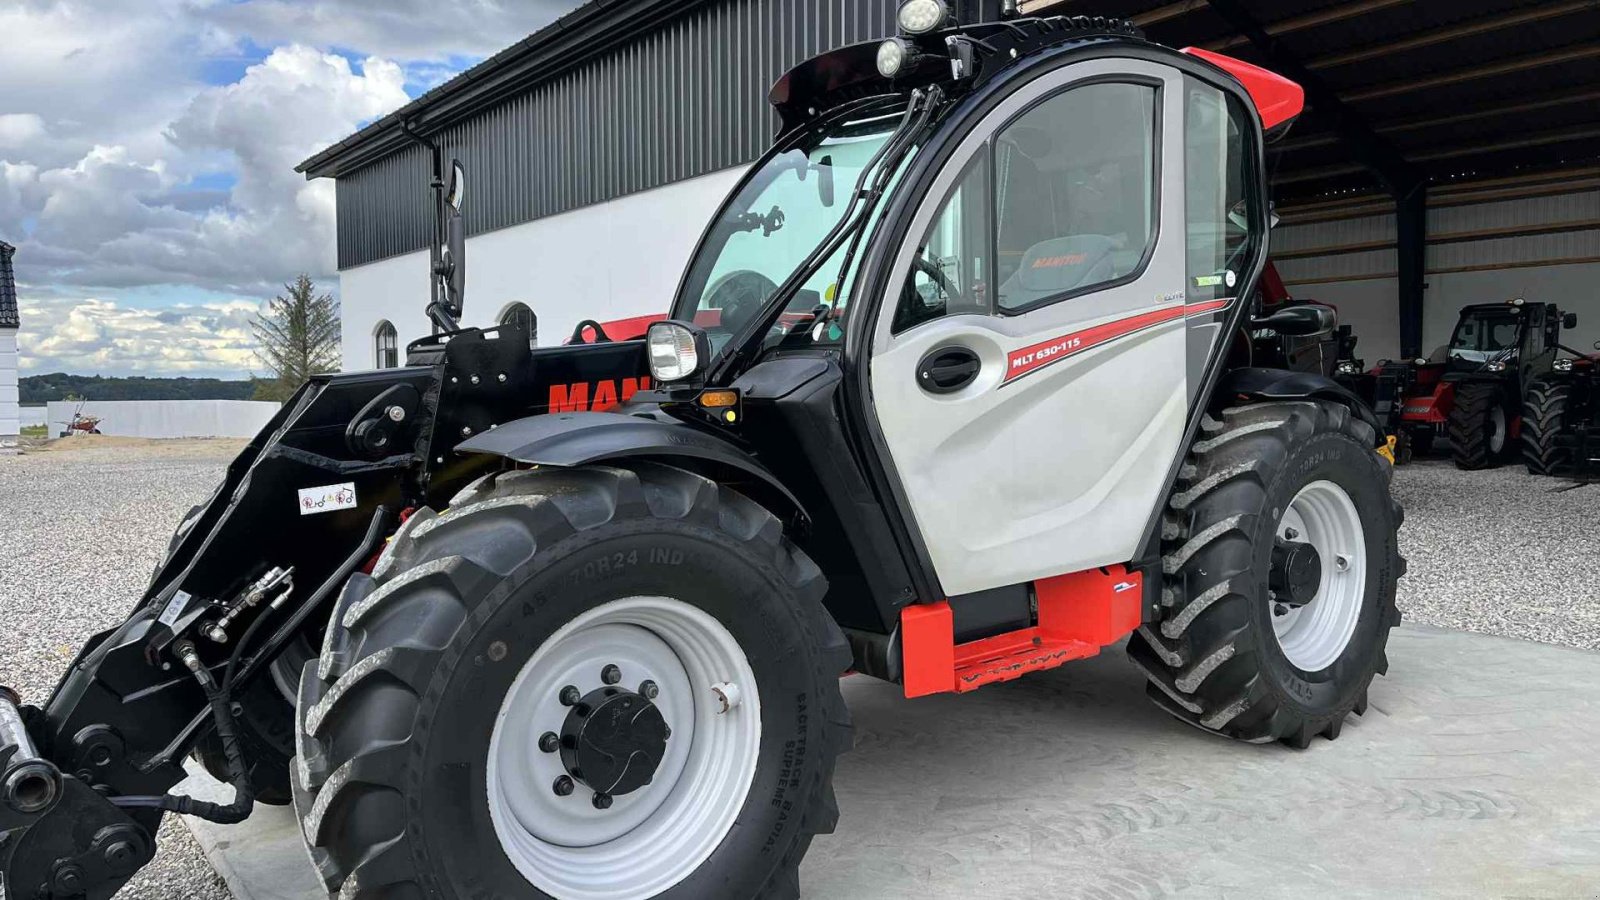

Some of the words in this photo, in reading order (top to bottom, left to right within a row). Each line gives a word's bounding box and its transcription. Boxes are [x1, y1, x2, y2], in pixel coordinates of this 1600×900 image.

[1012, 353, 1035, 368] MLT
[1036, 337, 1081, 359] 630-115
[649, 547, 684, 565] IND
[771, 740, 796, 808] SUPREME
